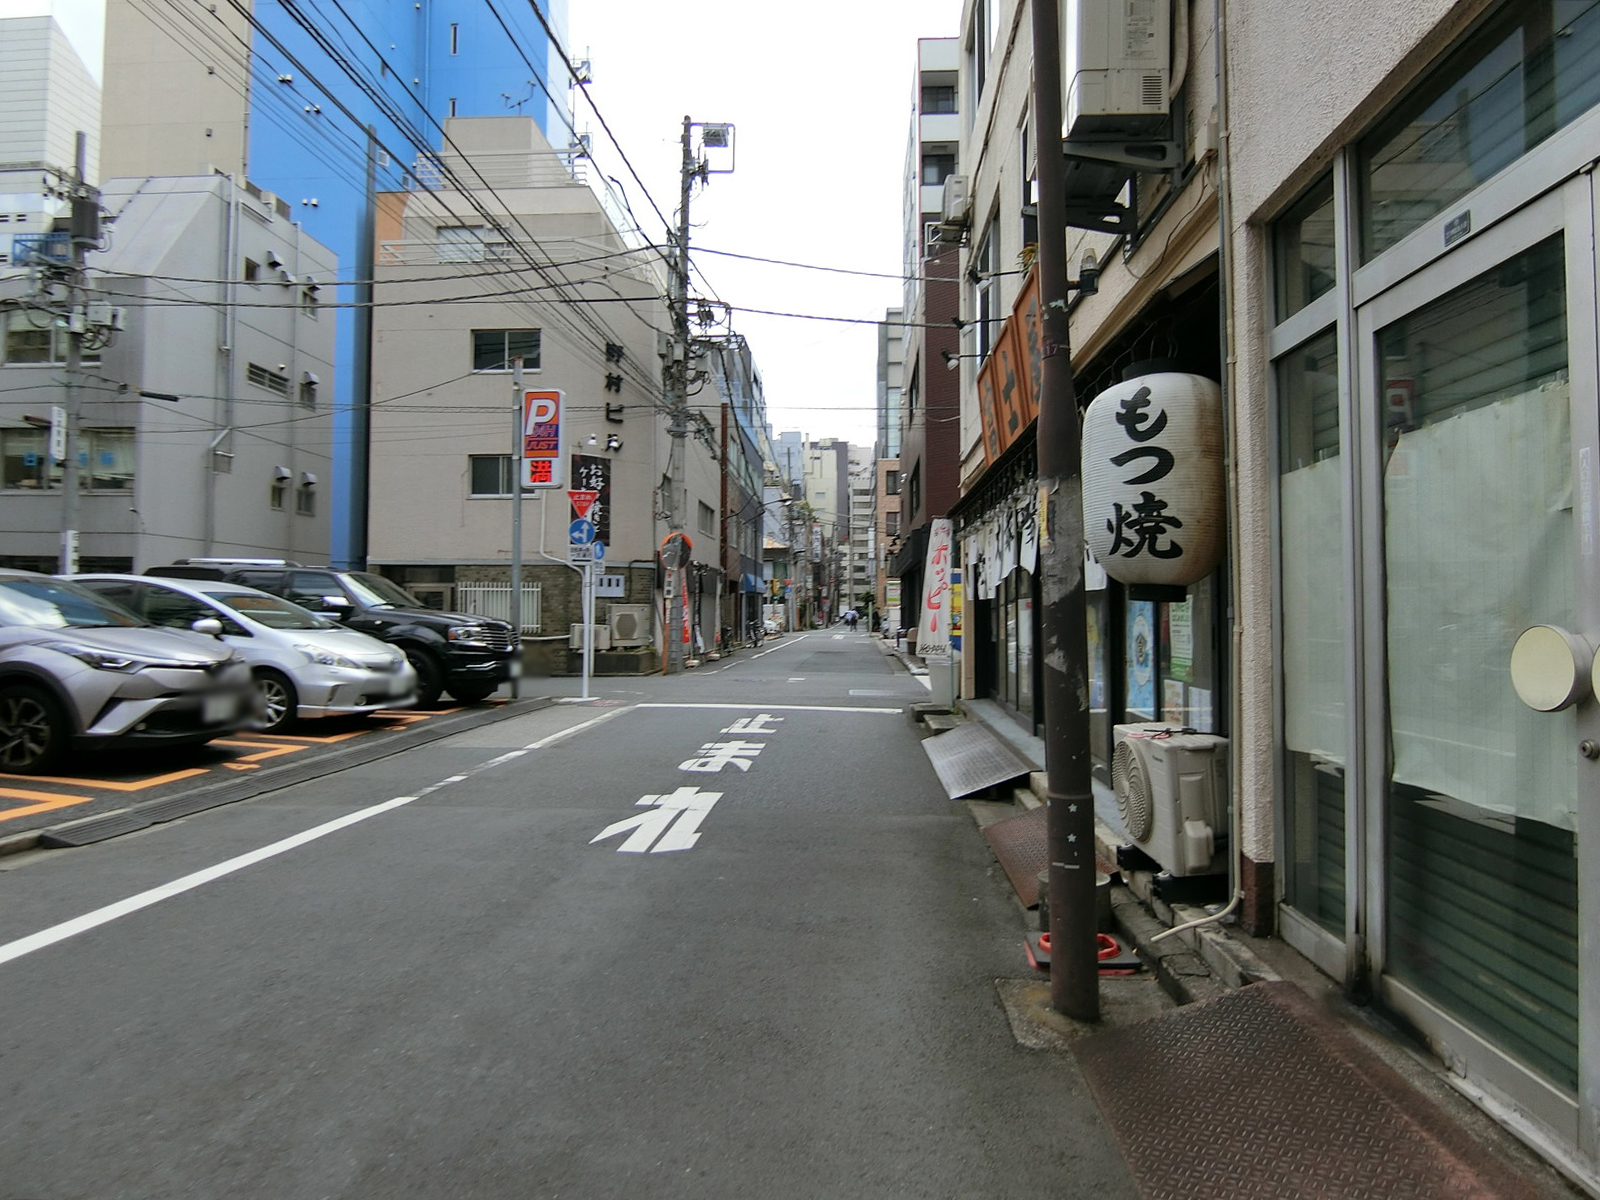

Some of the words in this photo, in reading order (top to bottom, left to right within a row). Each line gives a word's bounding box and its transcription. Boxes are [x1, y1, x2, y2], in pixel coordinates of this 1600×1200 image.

[525, 398, 557, 435] P
[526, 440, 557, 450] JUST
[530, 461, 551, 482] 満
[1106, 386, 1183, 559] もつ焼
[926, 542, 949, 632] ホッピー
[588, 713, 785, 854] 止まれ
